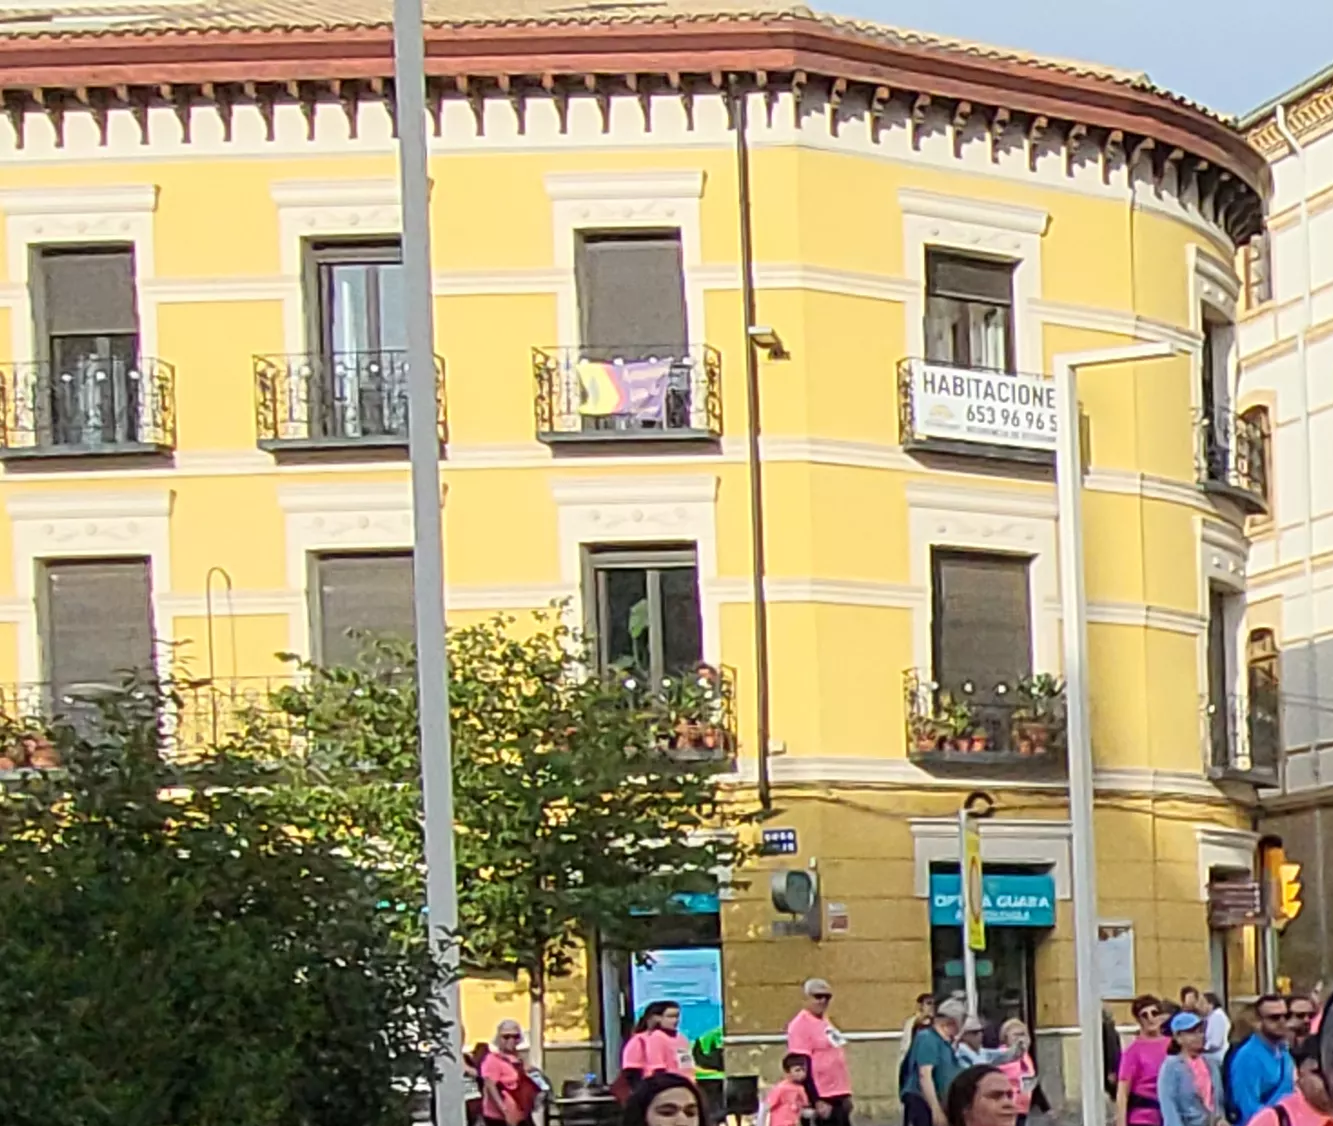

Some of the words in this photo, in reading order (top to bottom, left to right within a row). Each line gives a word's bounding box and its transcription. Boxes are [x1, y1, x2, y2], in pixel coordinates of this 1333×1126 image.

[923, 371, 1056, 409] HABITACIONE
[966, 404, 996, 425] 653
[1001, 408, 1020, 428] 96
[1025, 411, 1045, 431] 96
